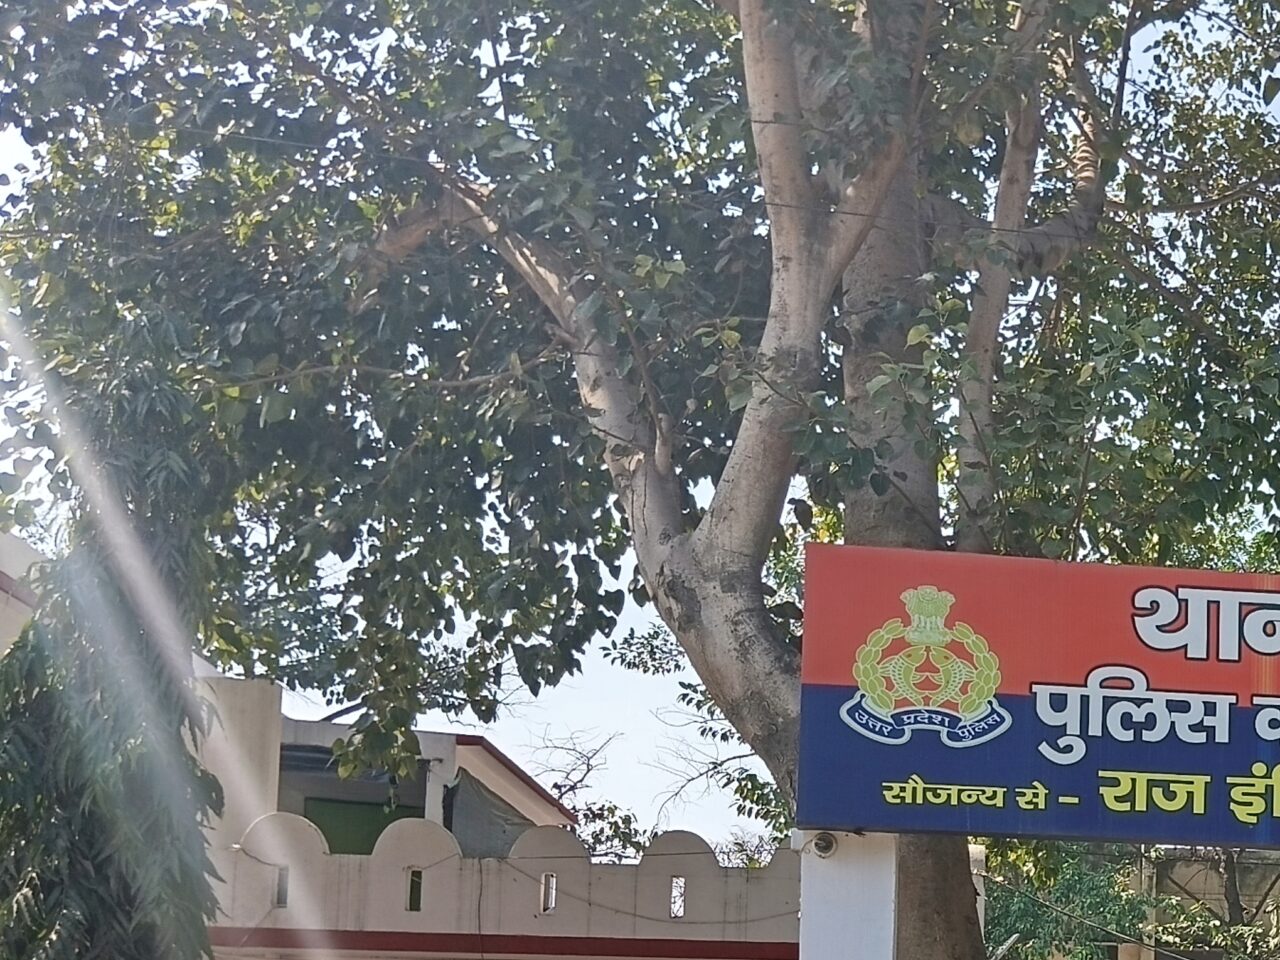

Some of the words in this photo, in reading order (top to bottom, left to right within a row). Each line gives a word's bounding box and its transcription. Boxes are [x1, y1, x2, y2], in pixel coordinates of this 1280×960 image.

[855, 709, 893, 736] उत्तर
[900, 709, 951, 727] प्रदेश
[957, 713, 1001, 742] पुलिस
[1031, 665, 1237, 766] पुलिस
[881, 773, 1007, 808] सौजन्य
[1015, 780, 1049, 810] से
[1098, 769, 1212, 815] राज
